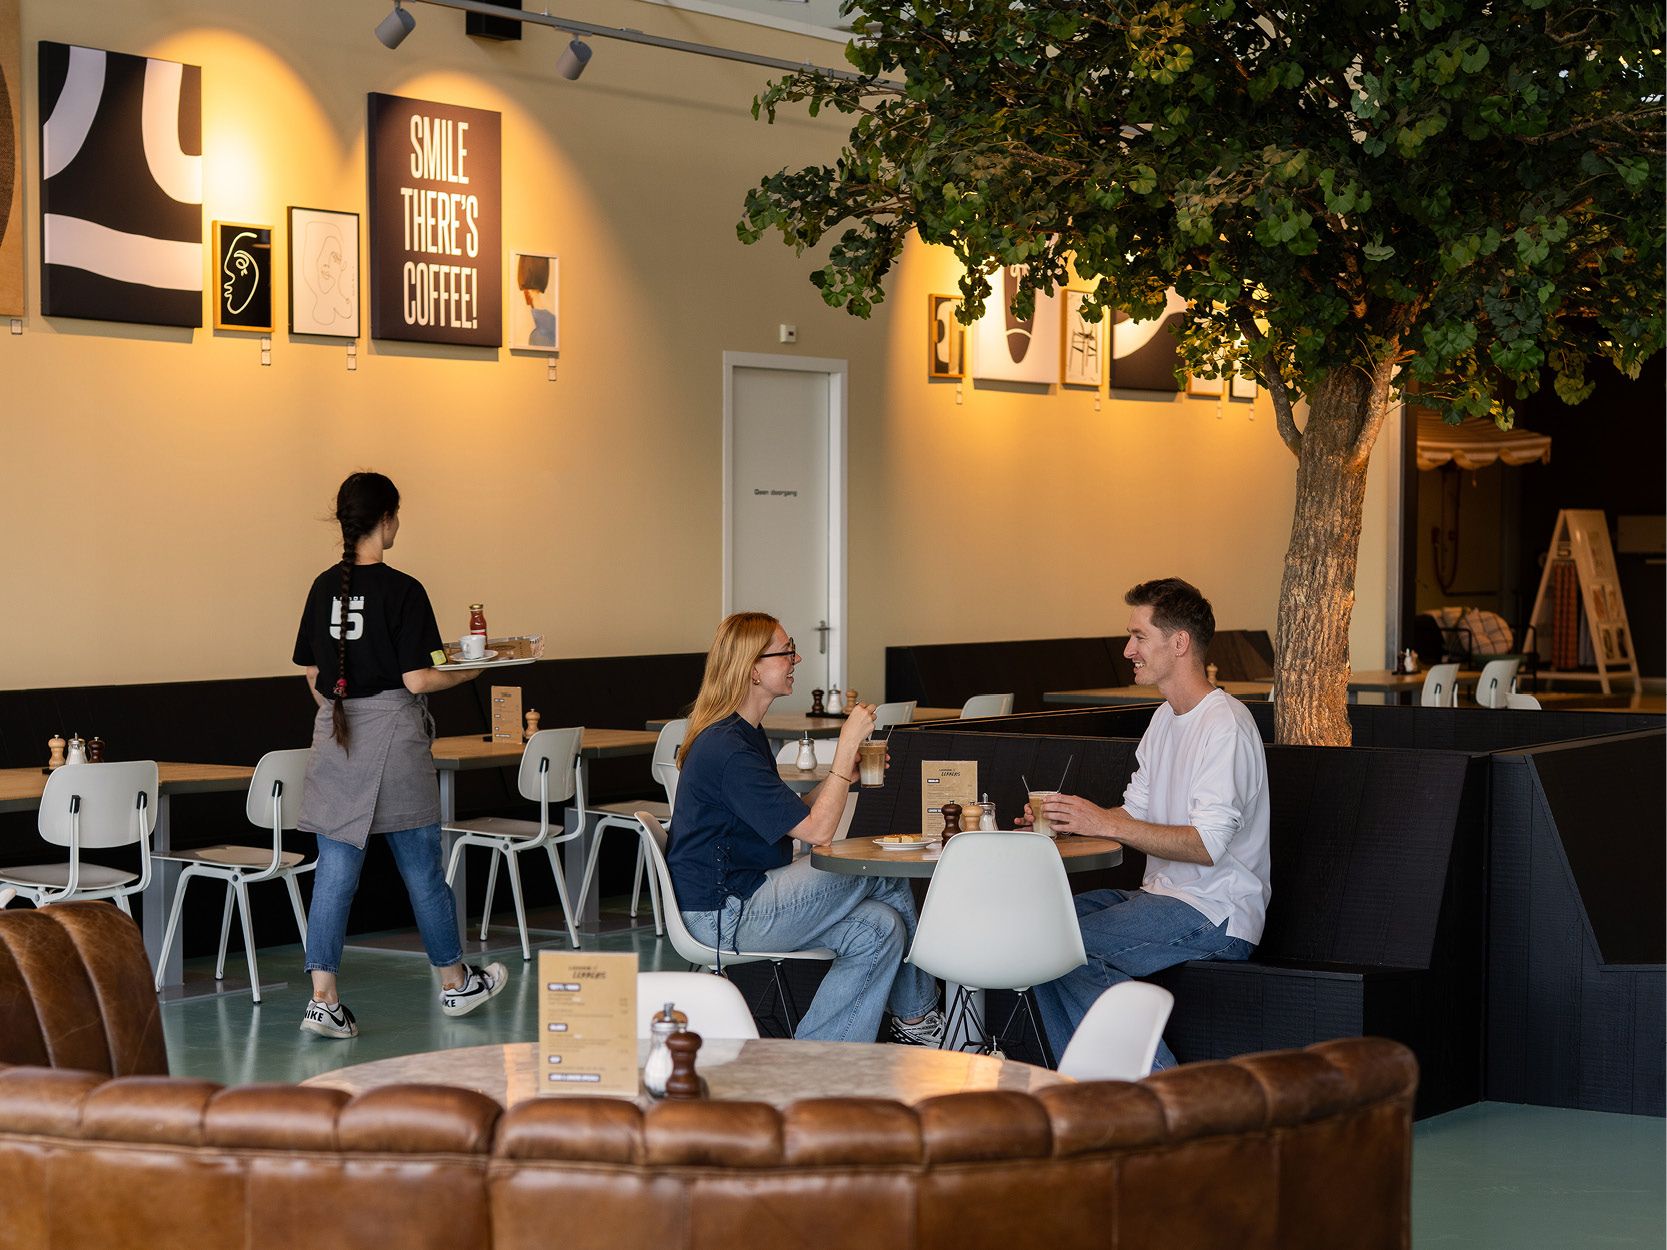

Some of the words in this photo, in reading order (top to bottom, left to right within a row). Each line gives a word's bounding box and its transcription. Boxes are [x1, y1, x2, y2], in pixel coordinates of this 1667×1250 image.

[410, 114, 470, 184] SMILE
[400, 187, 479, 258] THERE'S
[403, 261, 478, 330] COFFEE!
[329, 600, 364, 640] 5
